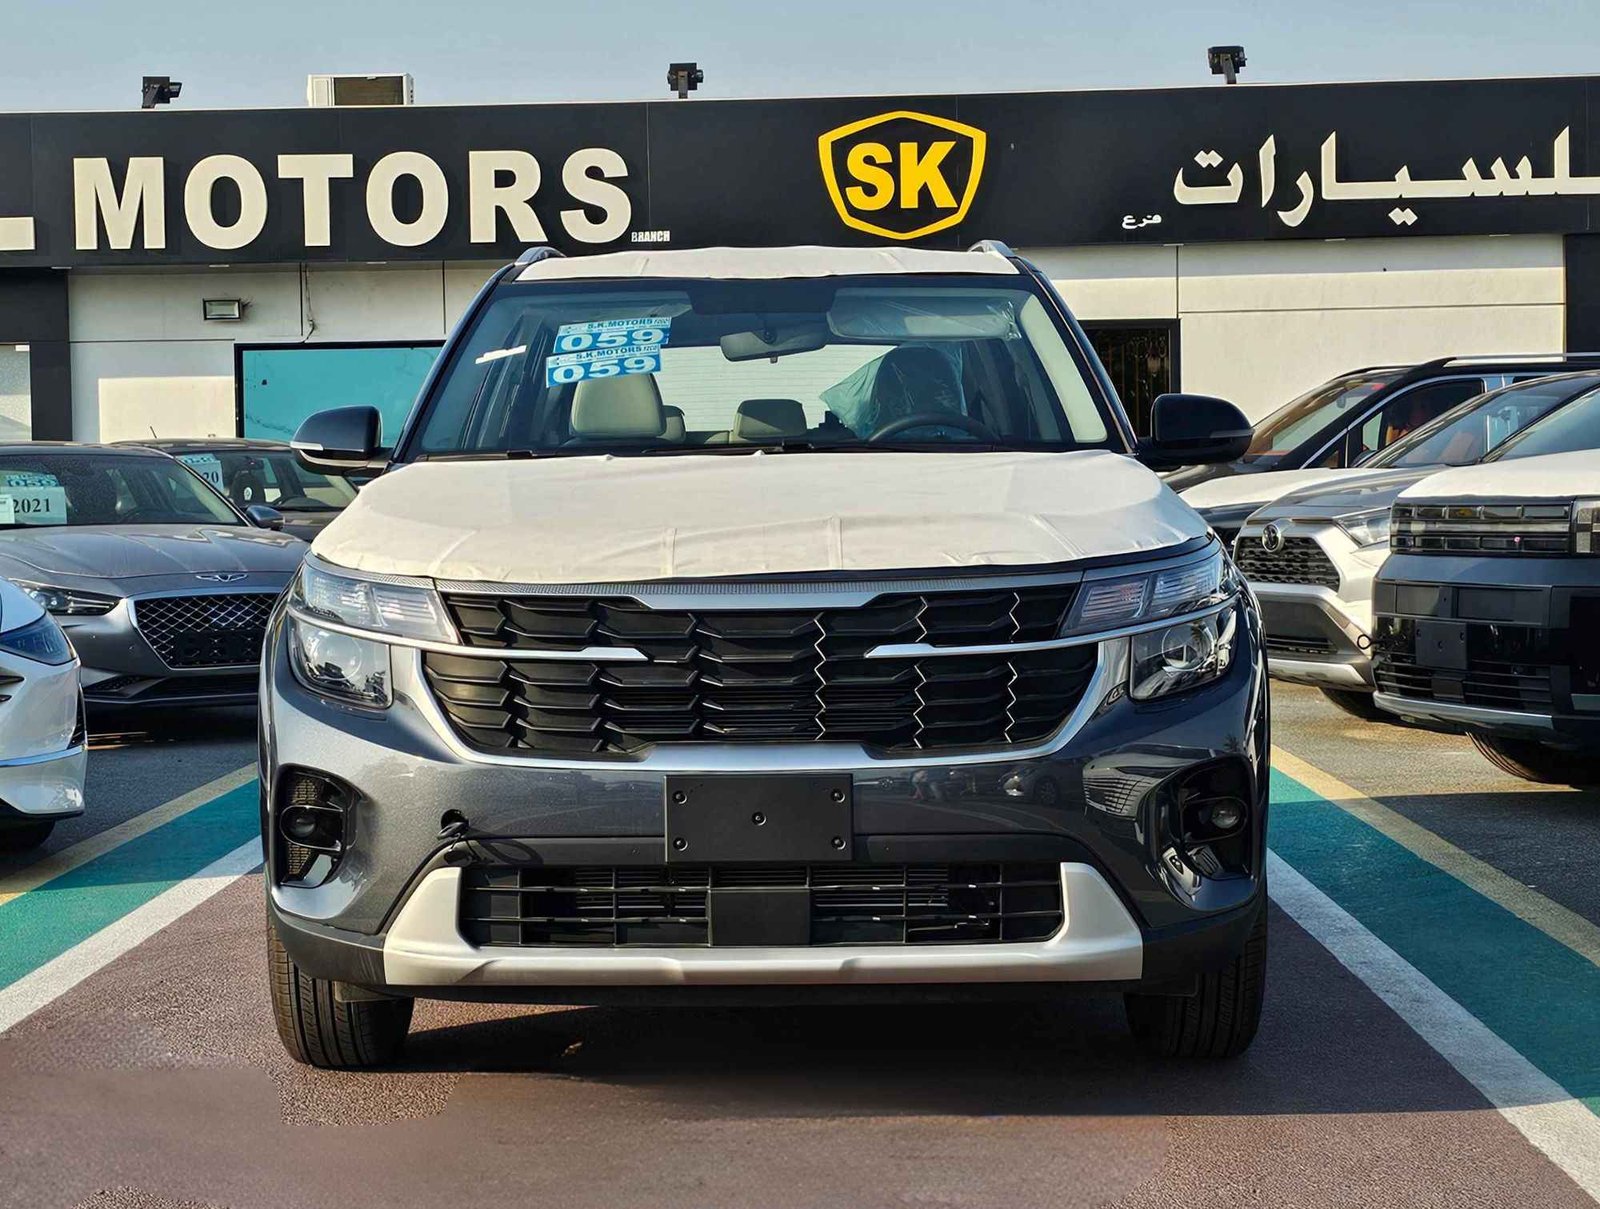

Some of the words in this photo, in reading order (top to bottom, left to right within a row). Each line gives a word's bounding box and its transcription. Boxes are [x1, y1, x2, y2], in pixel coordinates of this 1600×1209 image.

[846, 141, 958, 211] SK
[1174, 126, 1600, 228] لسيارات
[73, 148, 632, 251] MOTORS
[1122, 214, 1162, 229] فرع
[631, 230, 670, 242] BRANCH
[561, 329, 664, 352] 059
[552, 356, 656, 383] 059
[13, 498, 51, 513] 2021
